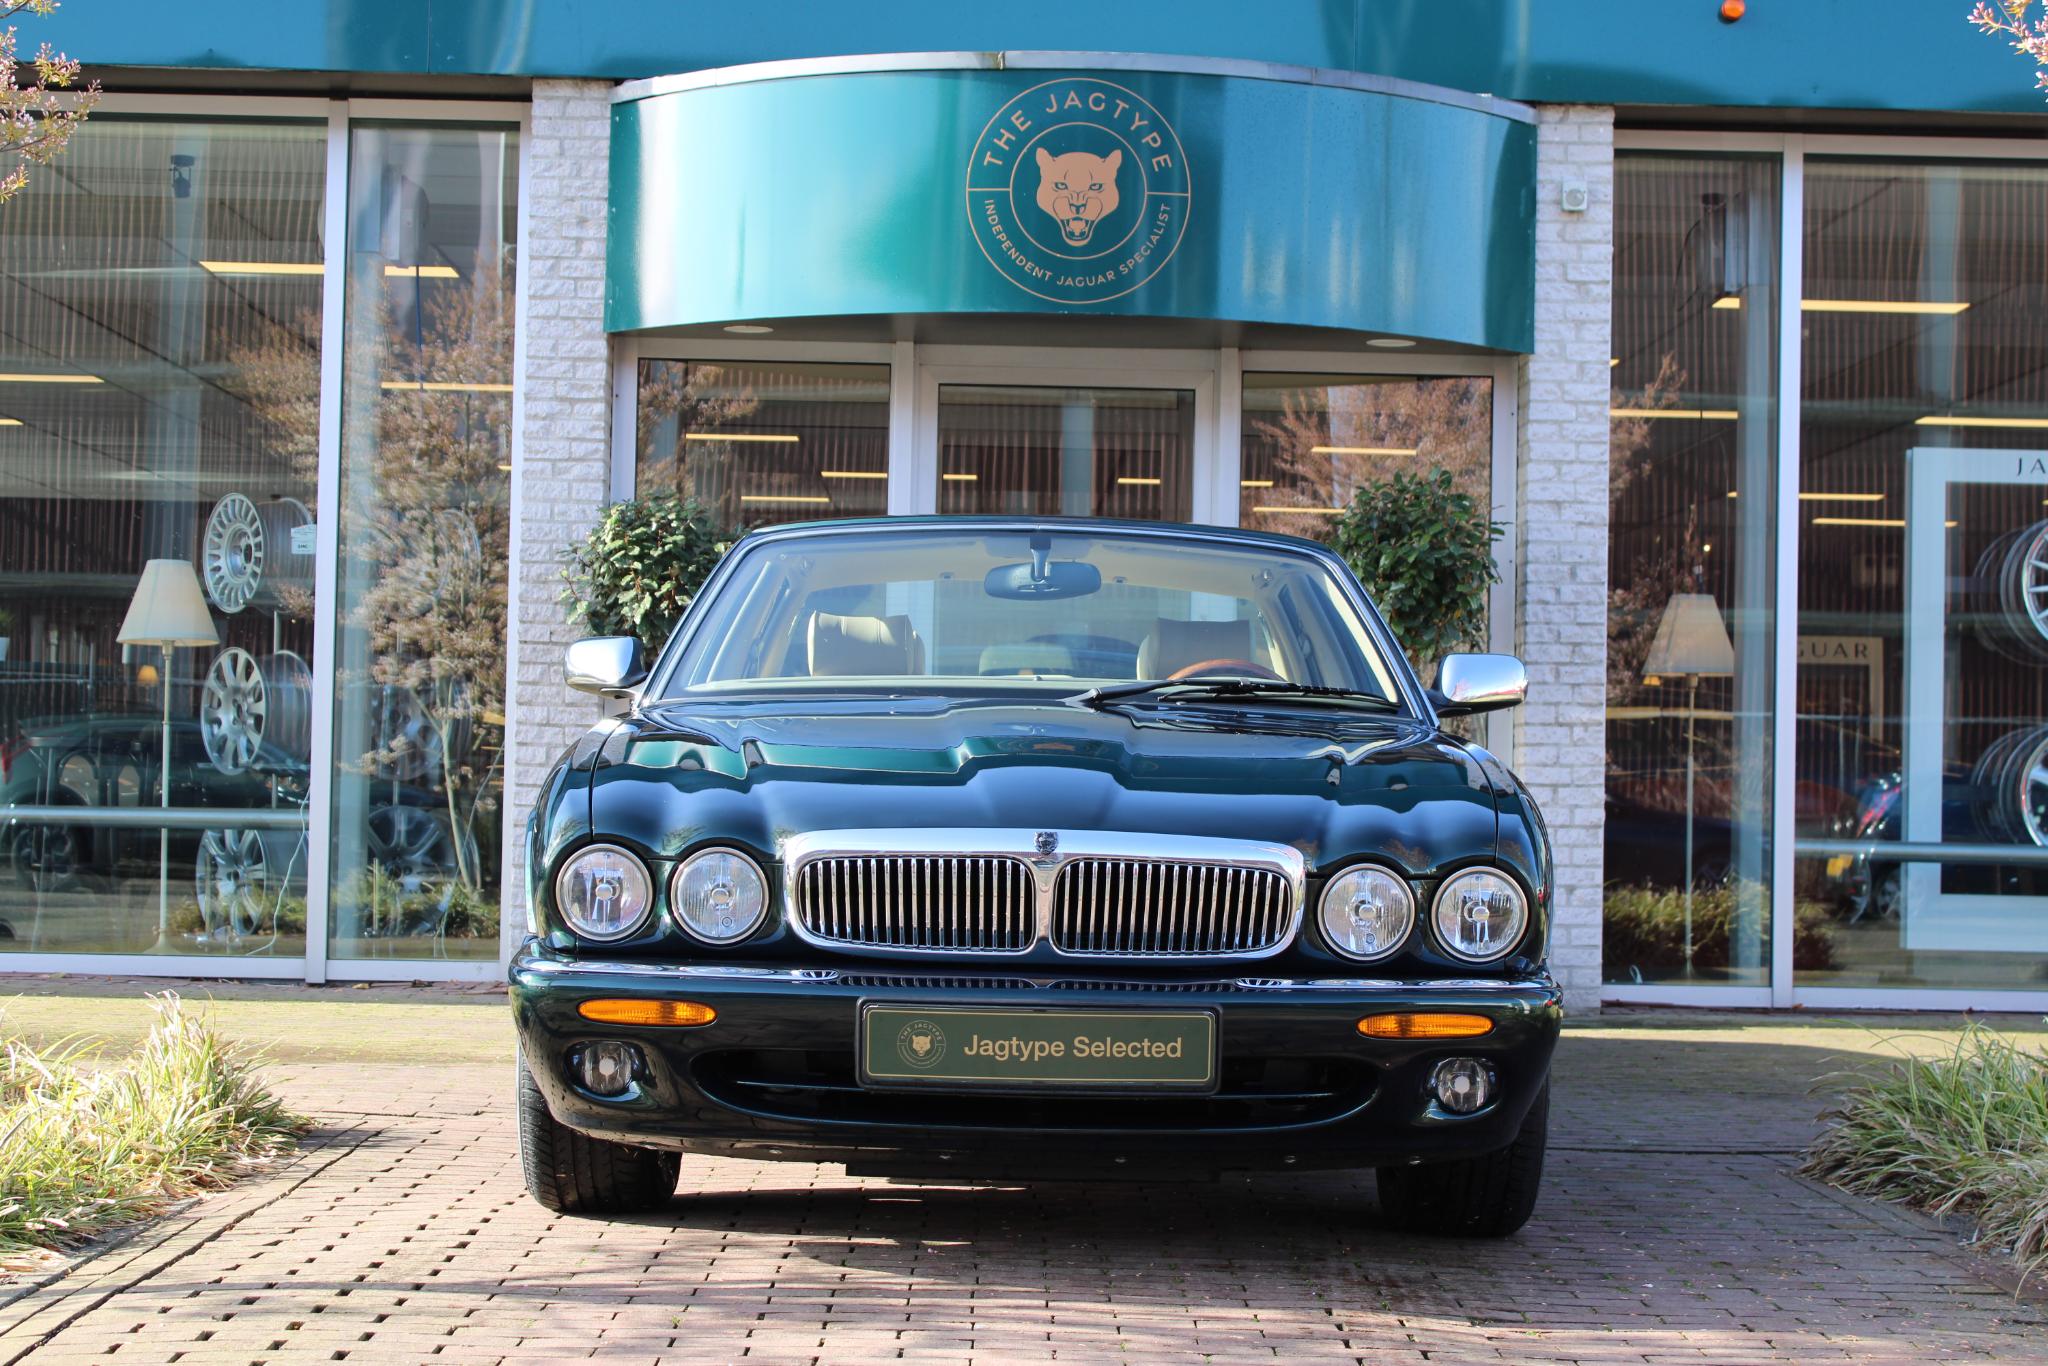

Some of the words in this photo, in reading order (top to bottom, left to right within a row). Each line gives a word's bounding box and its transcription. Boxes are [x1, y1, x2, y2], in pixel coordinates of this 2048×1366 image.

[984, 110, 1031, 166] THE
[1045, 90, 1172, 172] JAGTYPE
[984, 199, 1053, 281] INDEPENDENT
[1056, 272, 1116, 287] JAGUAR
[1119, 203, 1171, 275] SPECIALIST
[963, 1035, 1064, 1061] Jagtype
[1072, 1036, 1182, 1058] Selected
